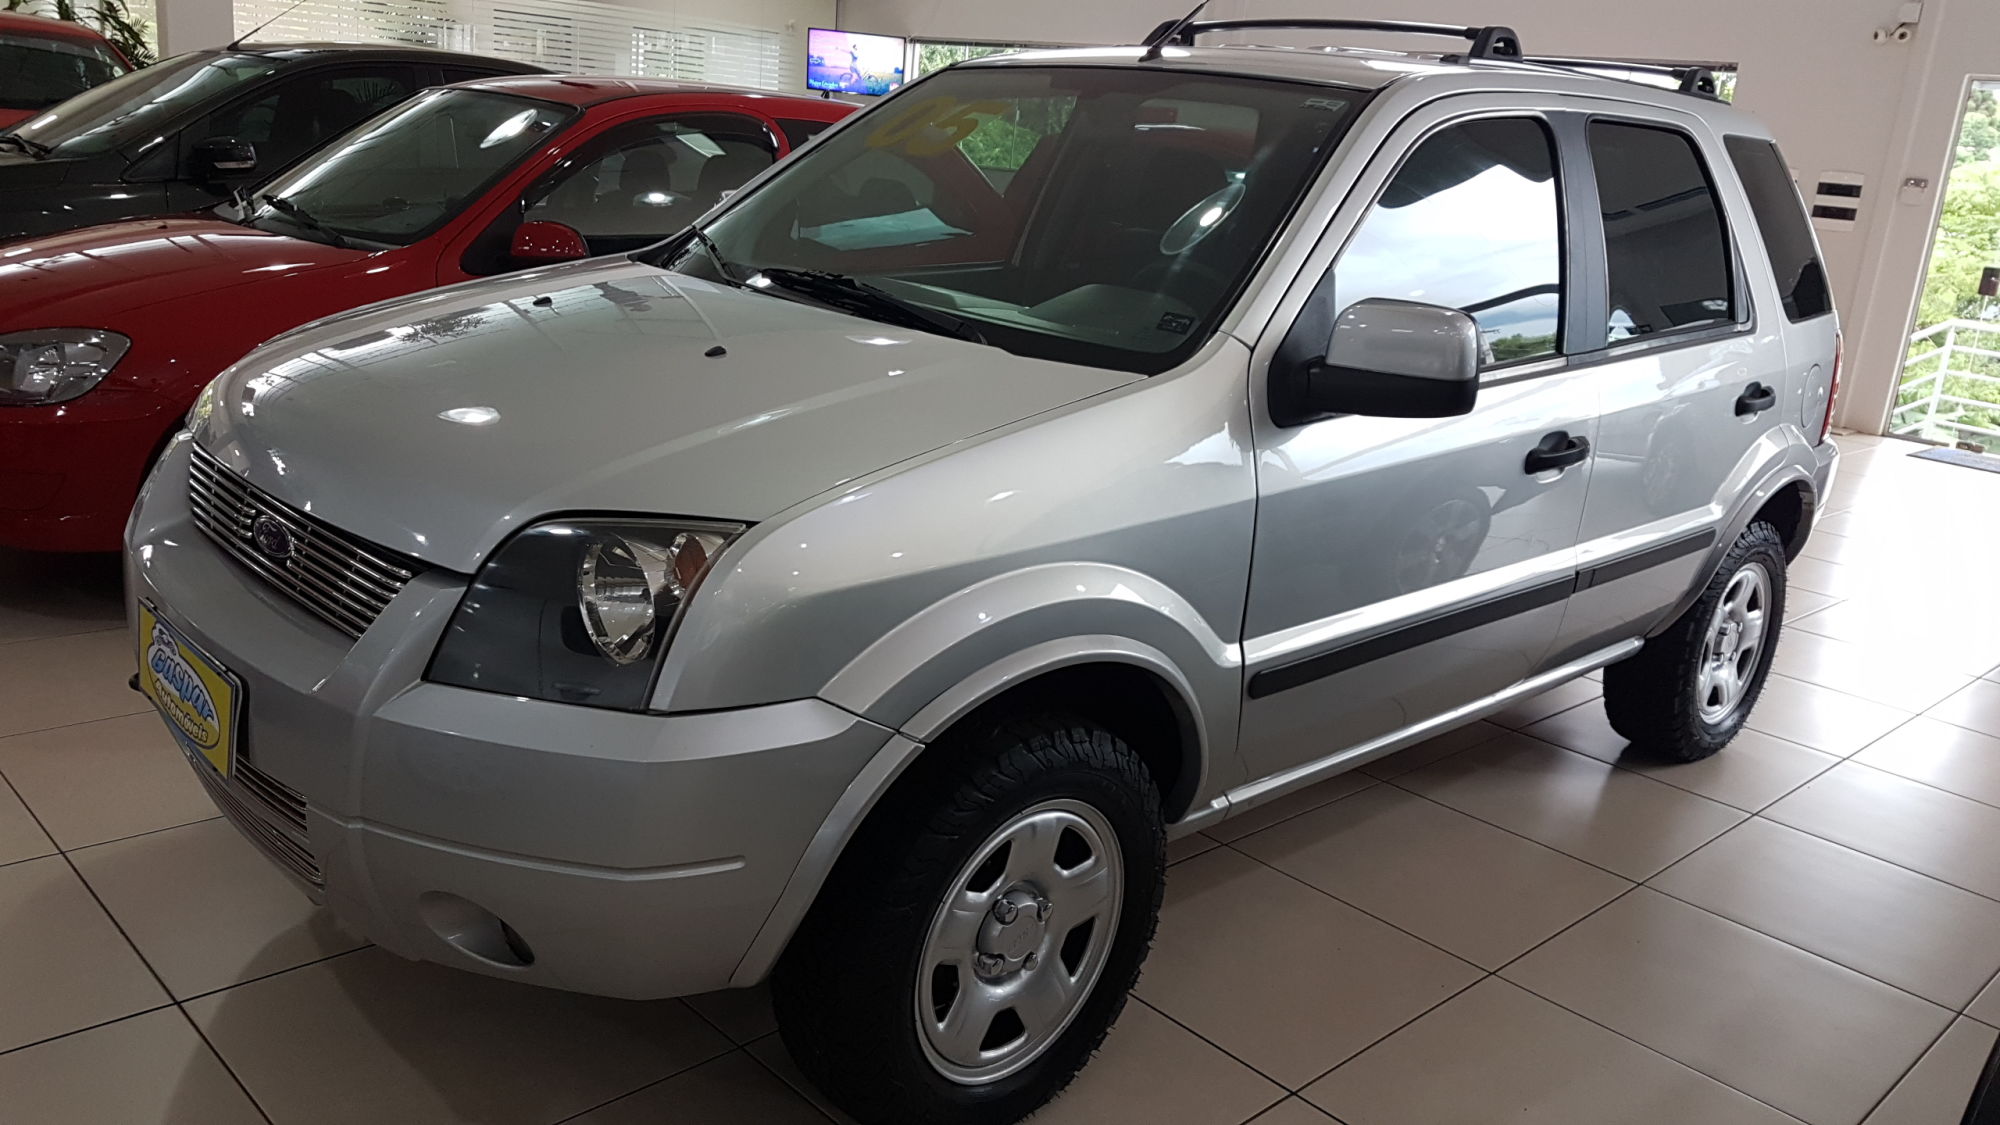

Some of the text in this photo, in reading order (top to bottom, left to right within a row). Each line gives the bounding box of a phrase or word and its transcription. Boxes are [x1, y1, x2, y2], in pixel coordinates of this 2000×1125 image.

[865, 97, 1010, 156] 05
[260, 521, 285, 551] Ford
[151, 648, 215, 722] Gaspar
